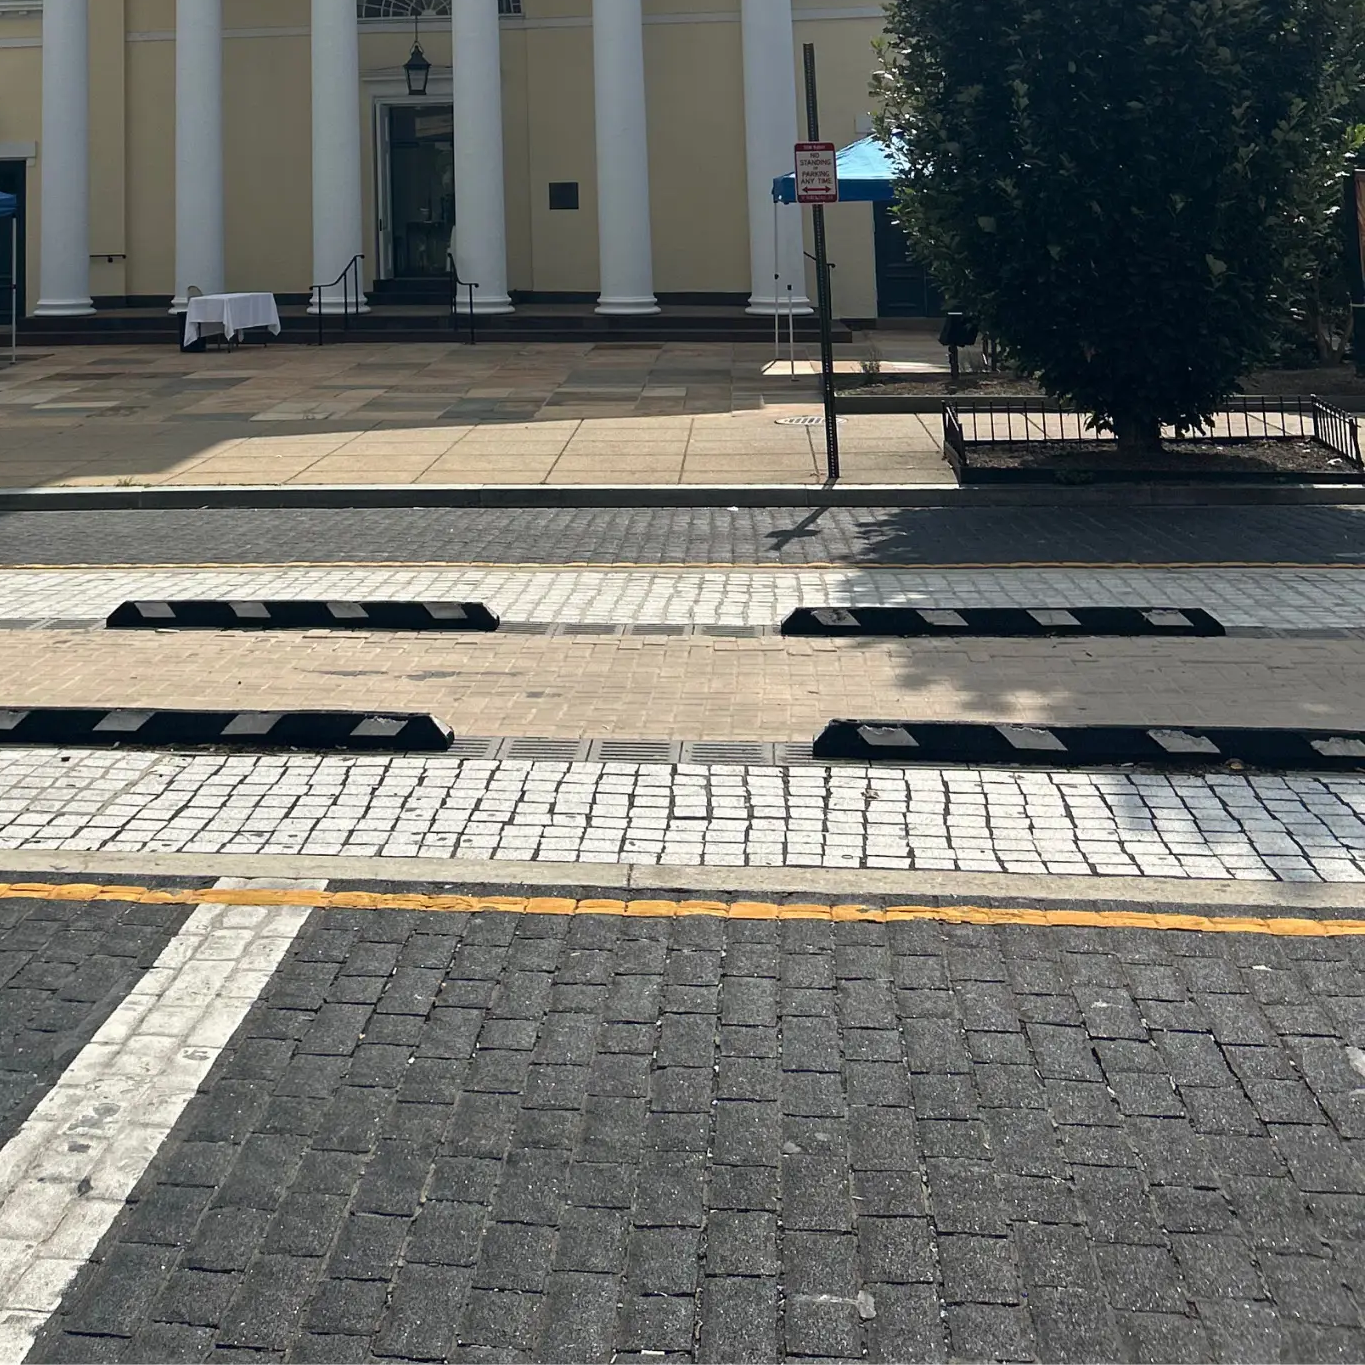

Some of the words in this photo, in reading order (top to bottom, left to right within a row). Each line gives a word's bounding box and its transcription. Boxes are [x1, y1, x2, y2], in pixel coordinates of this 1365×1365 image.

[799, 158, 832, 166] STANDING
[801, 170, 830, 178] PARKING
[818, 177, 833, 185] TIME
